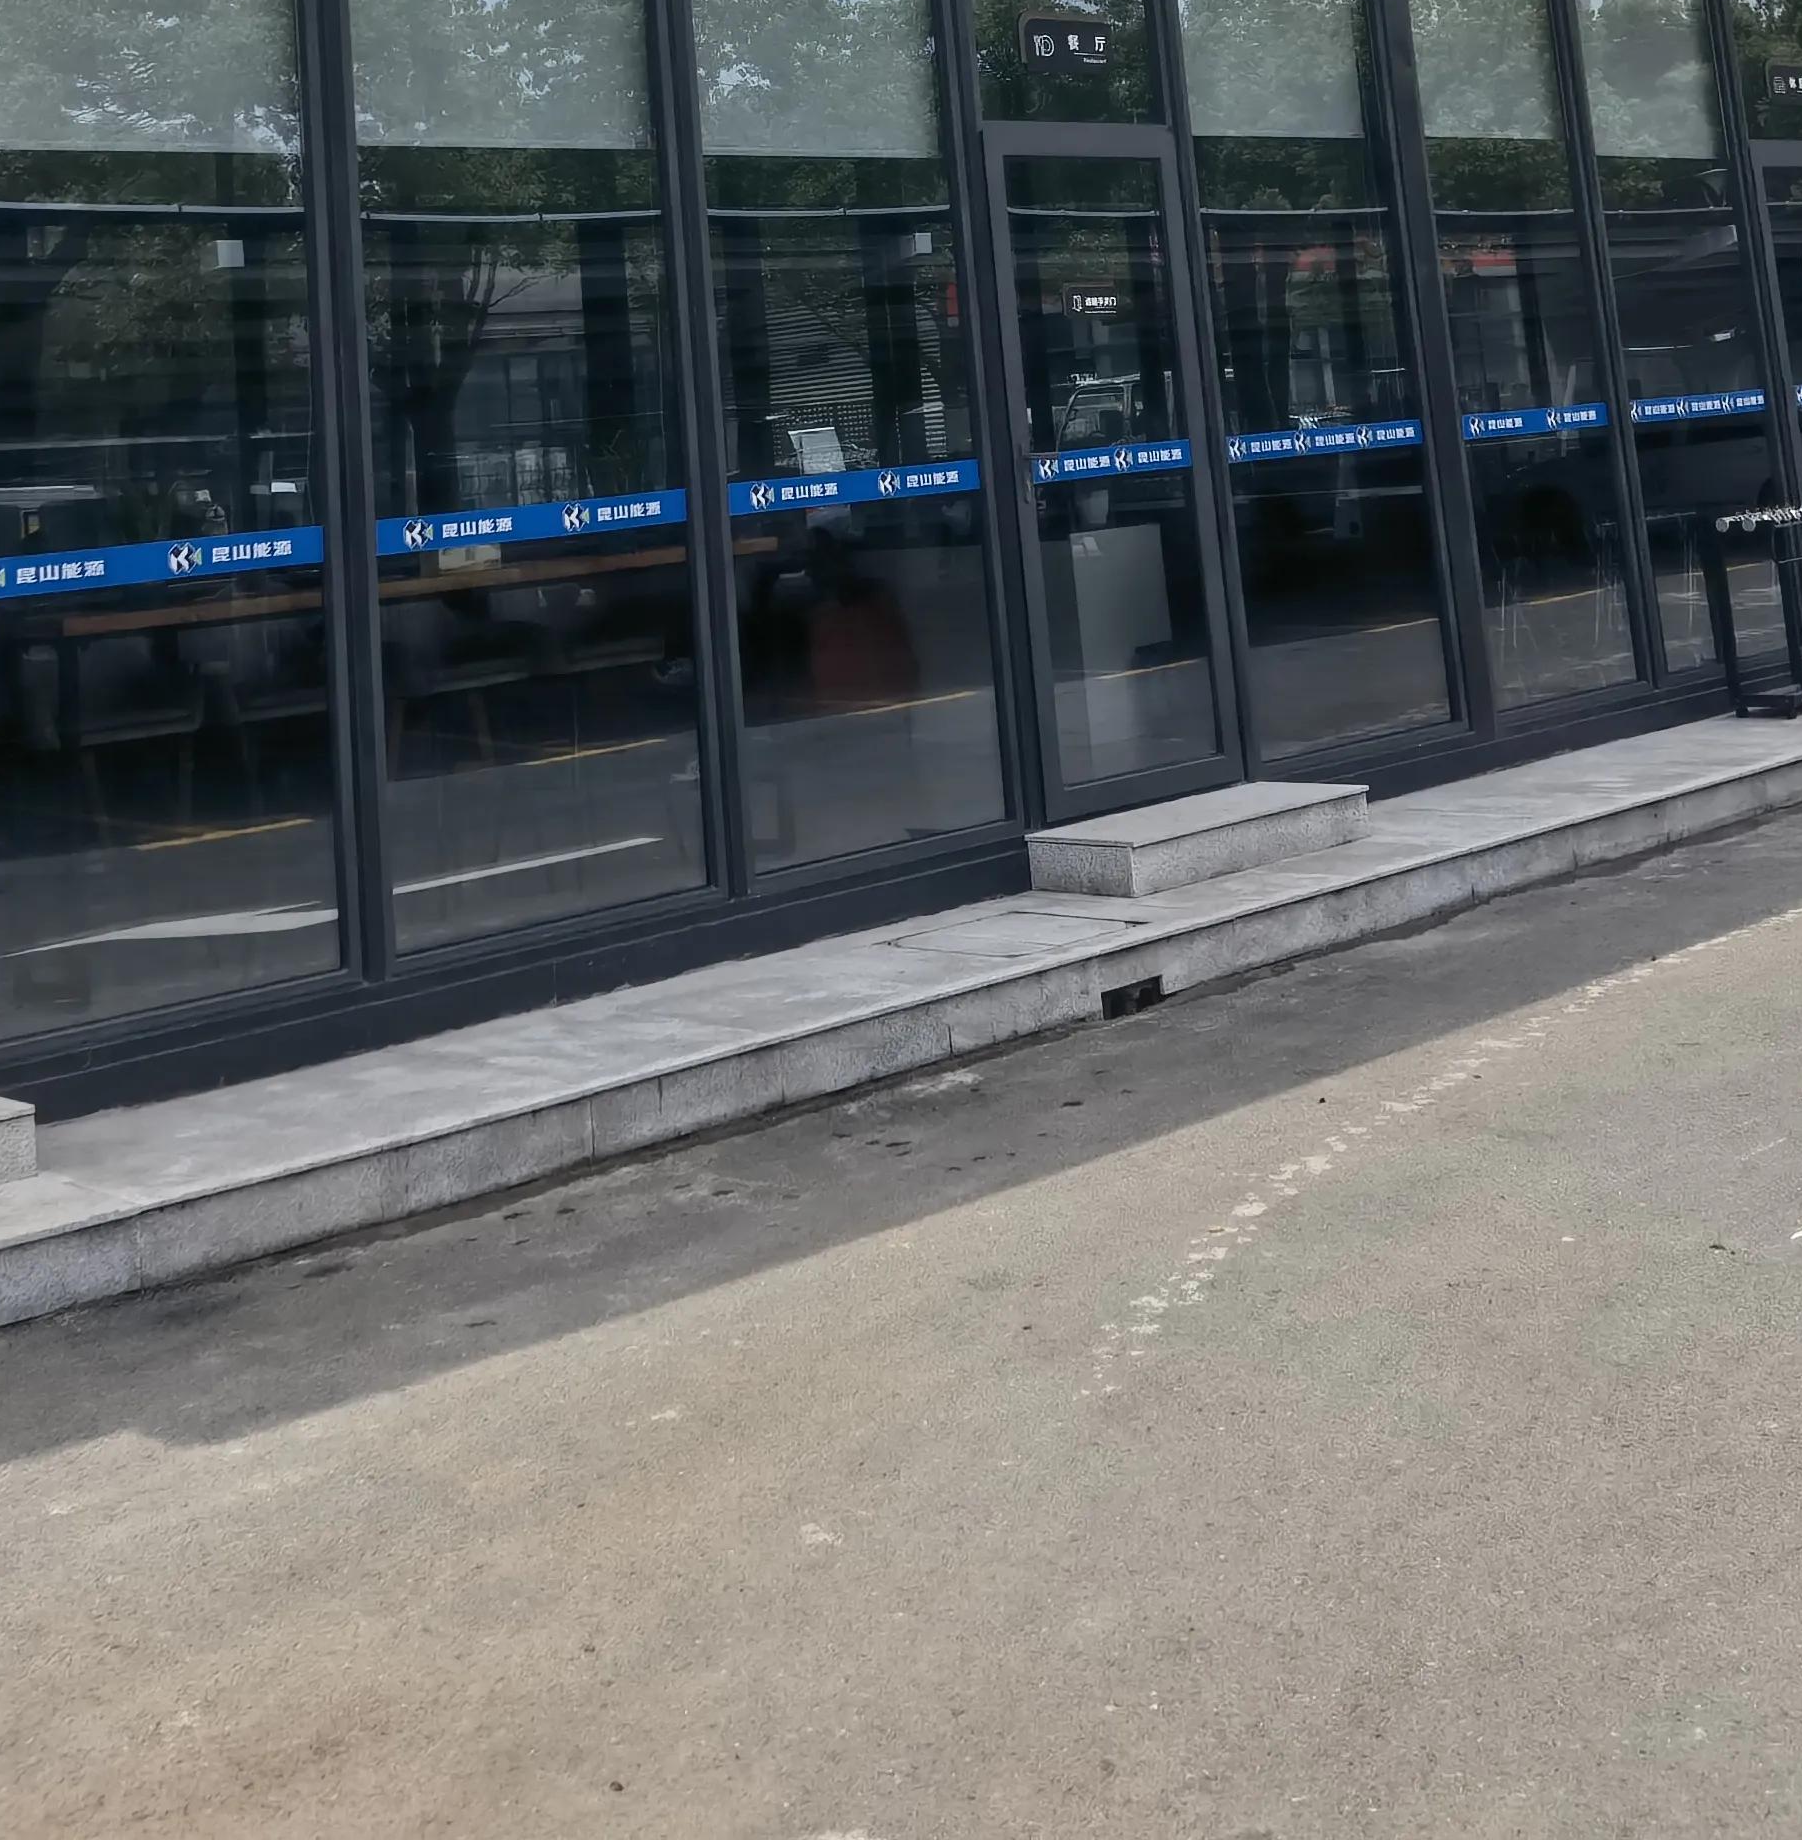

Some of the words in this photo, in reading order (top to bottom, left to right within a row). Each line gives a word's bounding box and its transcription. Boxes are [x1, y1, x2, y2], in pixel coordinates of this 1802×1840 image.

[443, 517, 512, 538] 昆山能源
[598, 501, 660, 521] 昆山能源
[17, 561, 104, 584] 昆山能源
[213, 541, 291, 562] 昆山能源
